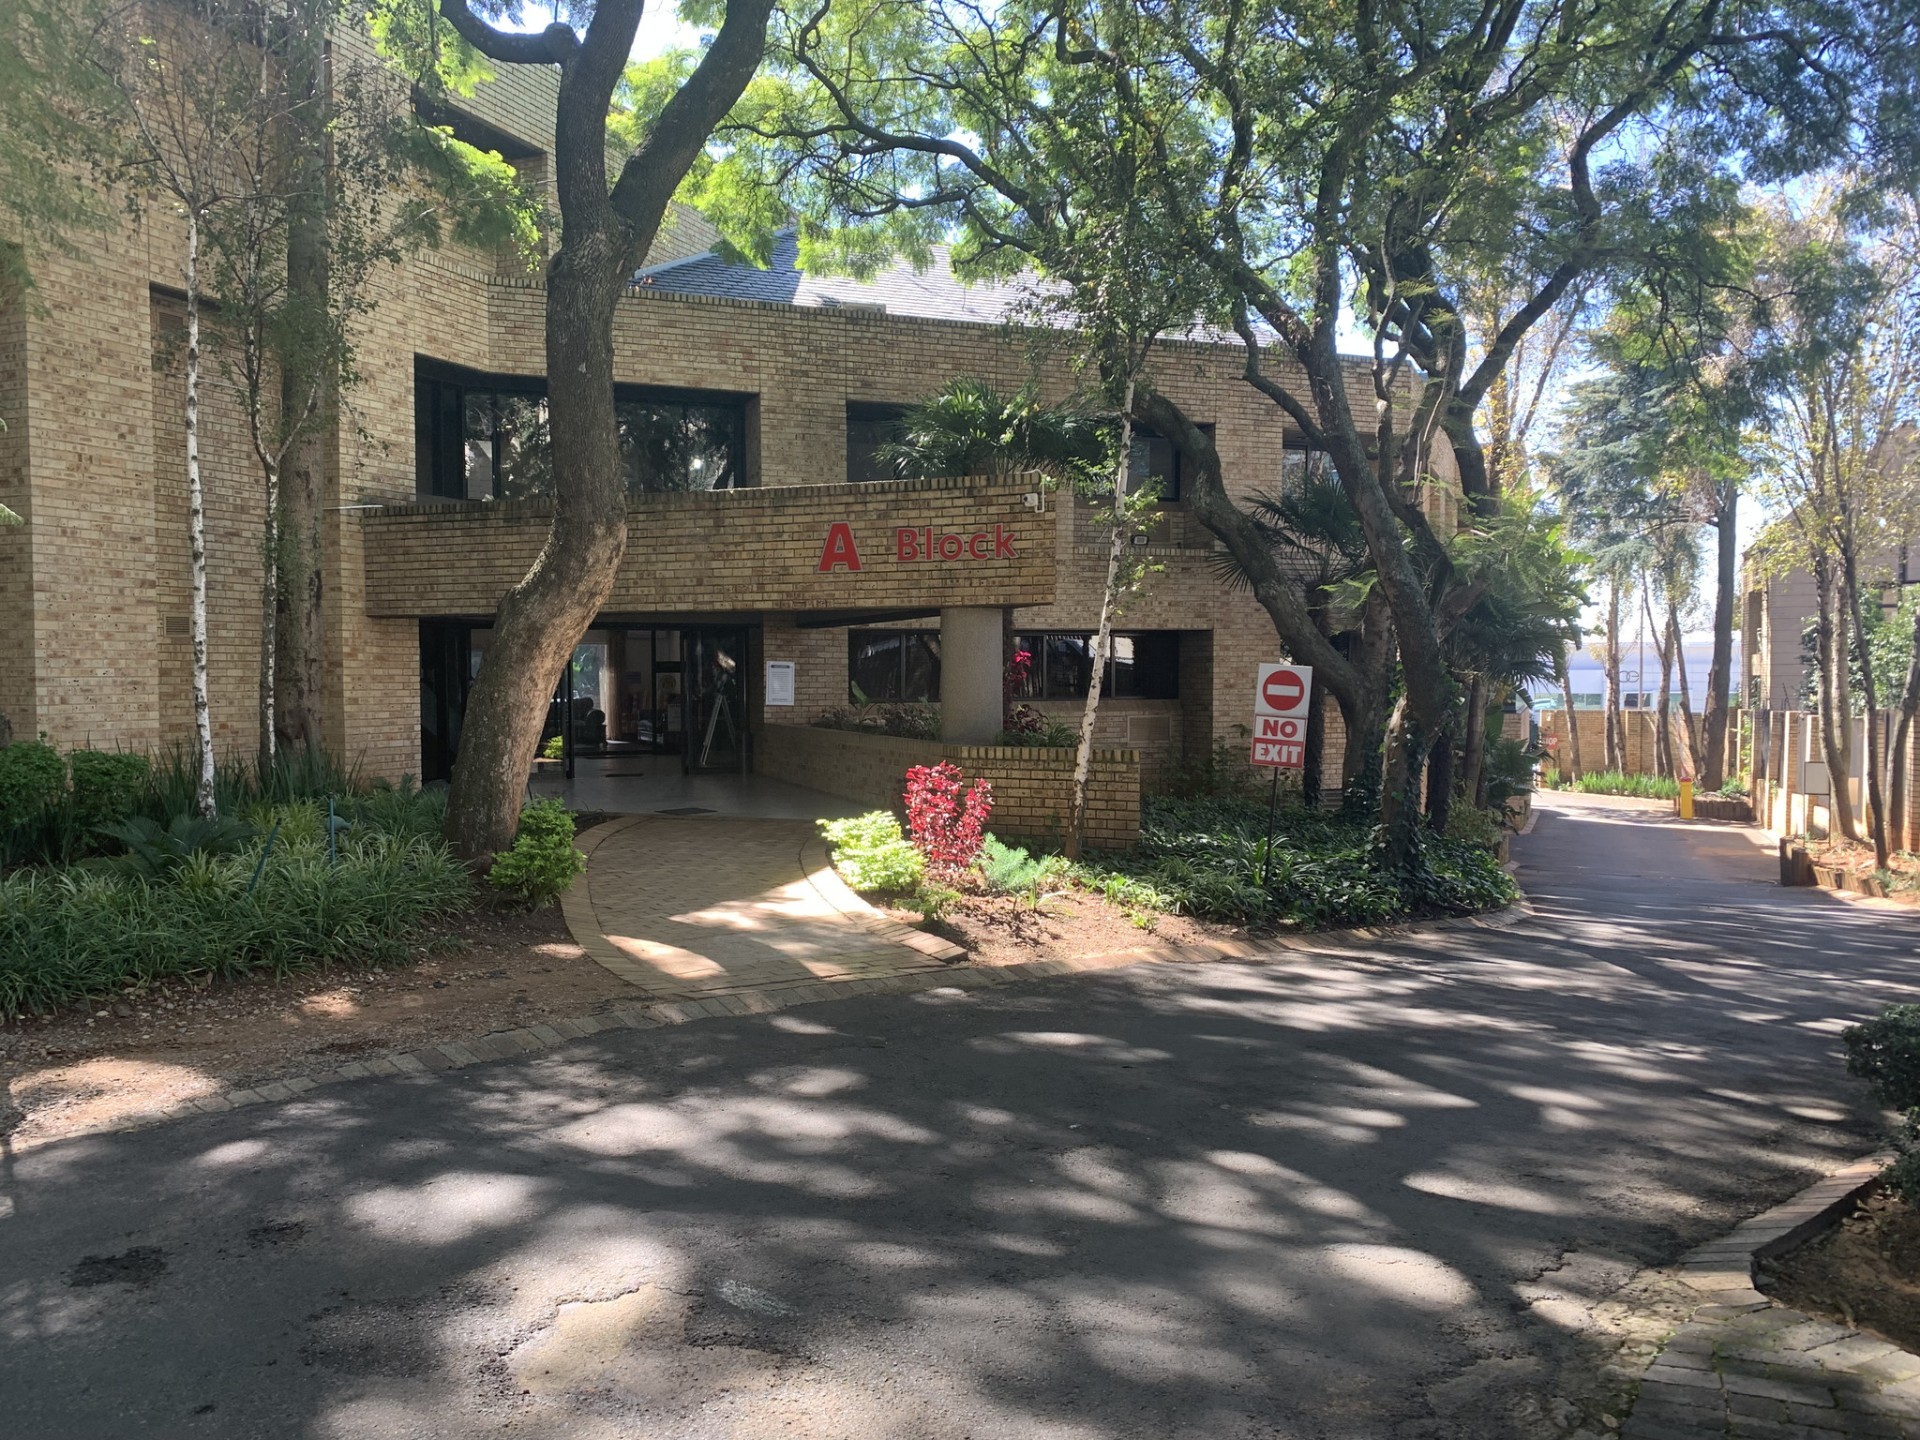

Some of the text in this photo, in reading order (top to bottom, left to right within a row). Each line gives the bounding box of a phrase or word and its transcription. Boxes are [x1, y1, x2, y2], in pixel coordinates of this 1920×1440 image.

[818, 522, 1019, 572] A Block
[1262, 720, 1298, 738] NO
[1255, 743, 1301, 764] EXIT
